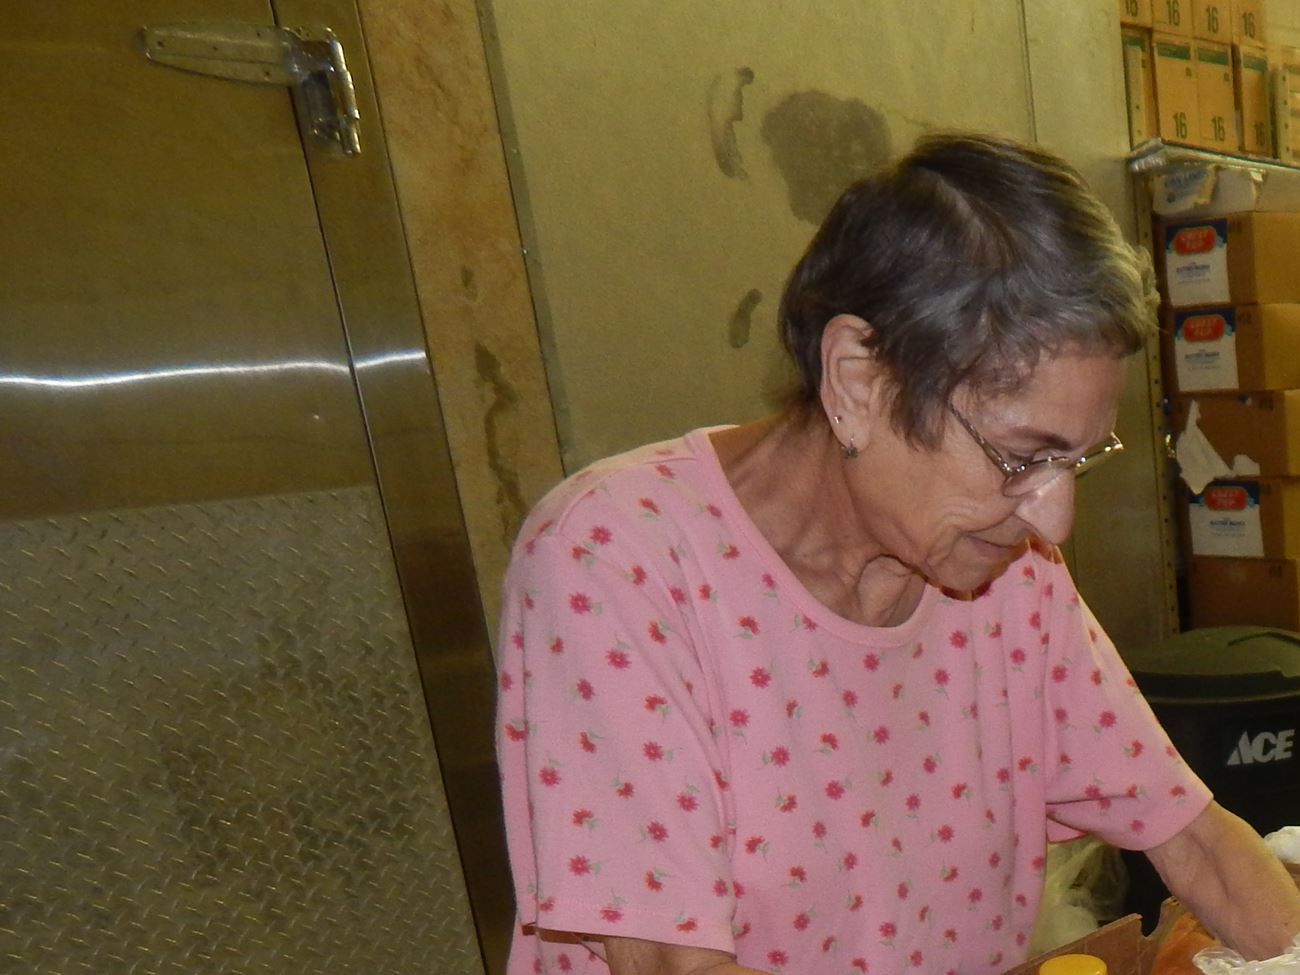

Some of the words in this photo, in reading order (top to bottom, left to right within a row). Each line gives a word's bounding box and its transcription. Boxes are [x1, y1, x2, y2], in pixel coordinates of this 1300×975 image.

[1166, 0, 1180, 26] 16
[1206, 6, 1219, 34] 16
[1243, 12, 1256, 39] 16
[1173, 111, 1188, 139] 16
[1211, 116, 1226, 142] 16
[1254, 121, 1266, 147] 16
[1227, 729, 1296, 766] ACE
